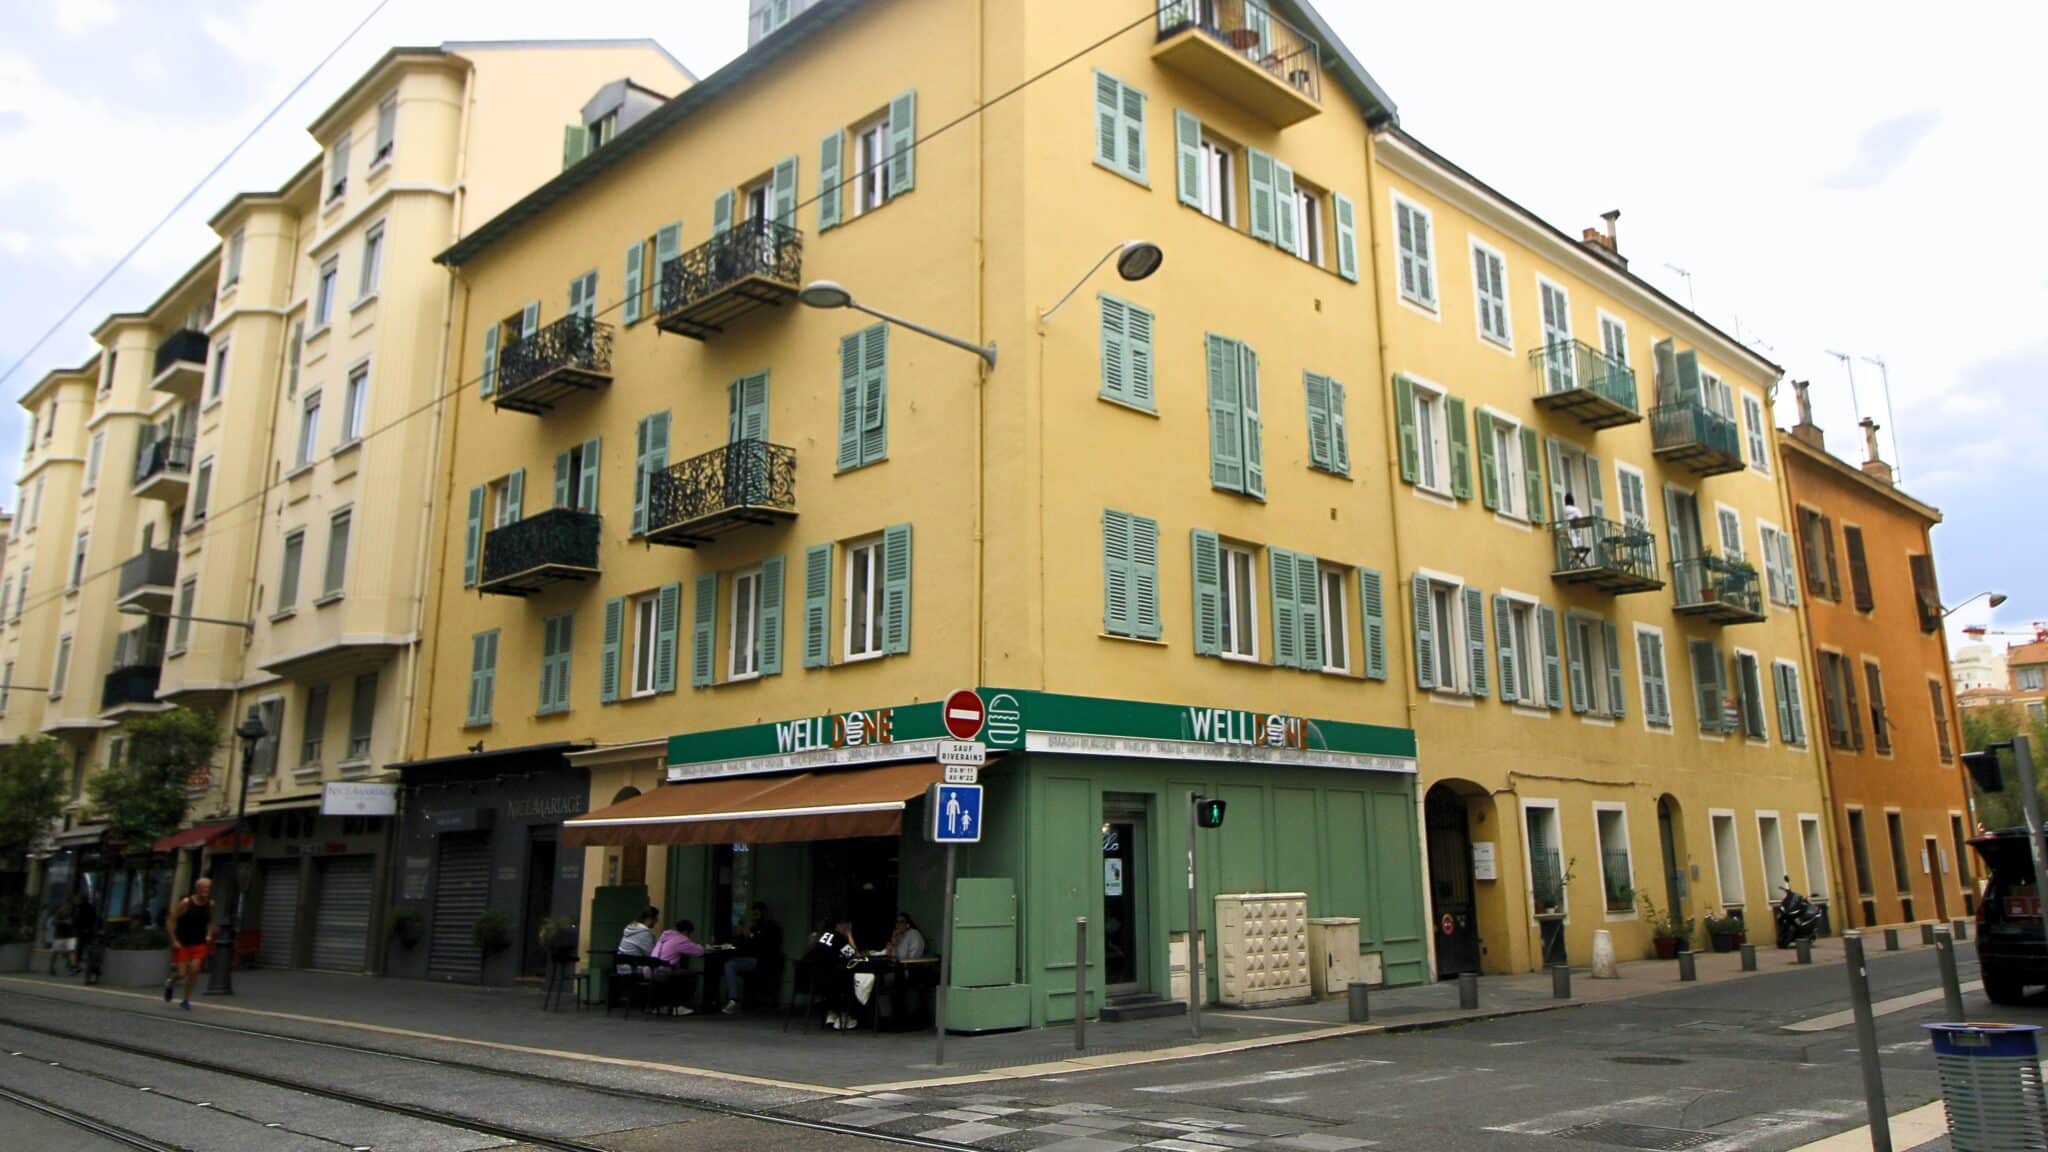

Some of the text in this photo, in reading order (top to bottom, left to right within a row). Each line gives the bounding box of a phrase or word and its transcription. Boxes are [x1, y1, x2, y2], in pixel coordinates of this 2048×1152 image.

[1189, 707, 1252, 745] WELL
[776, 717, 828, 753] WELL
[953, 744, 973, 752] SAUF
[942, 752, 982, 760] RIVERAINS
[819, 932, 835, 946] EL
